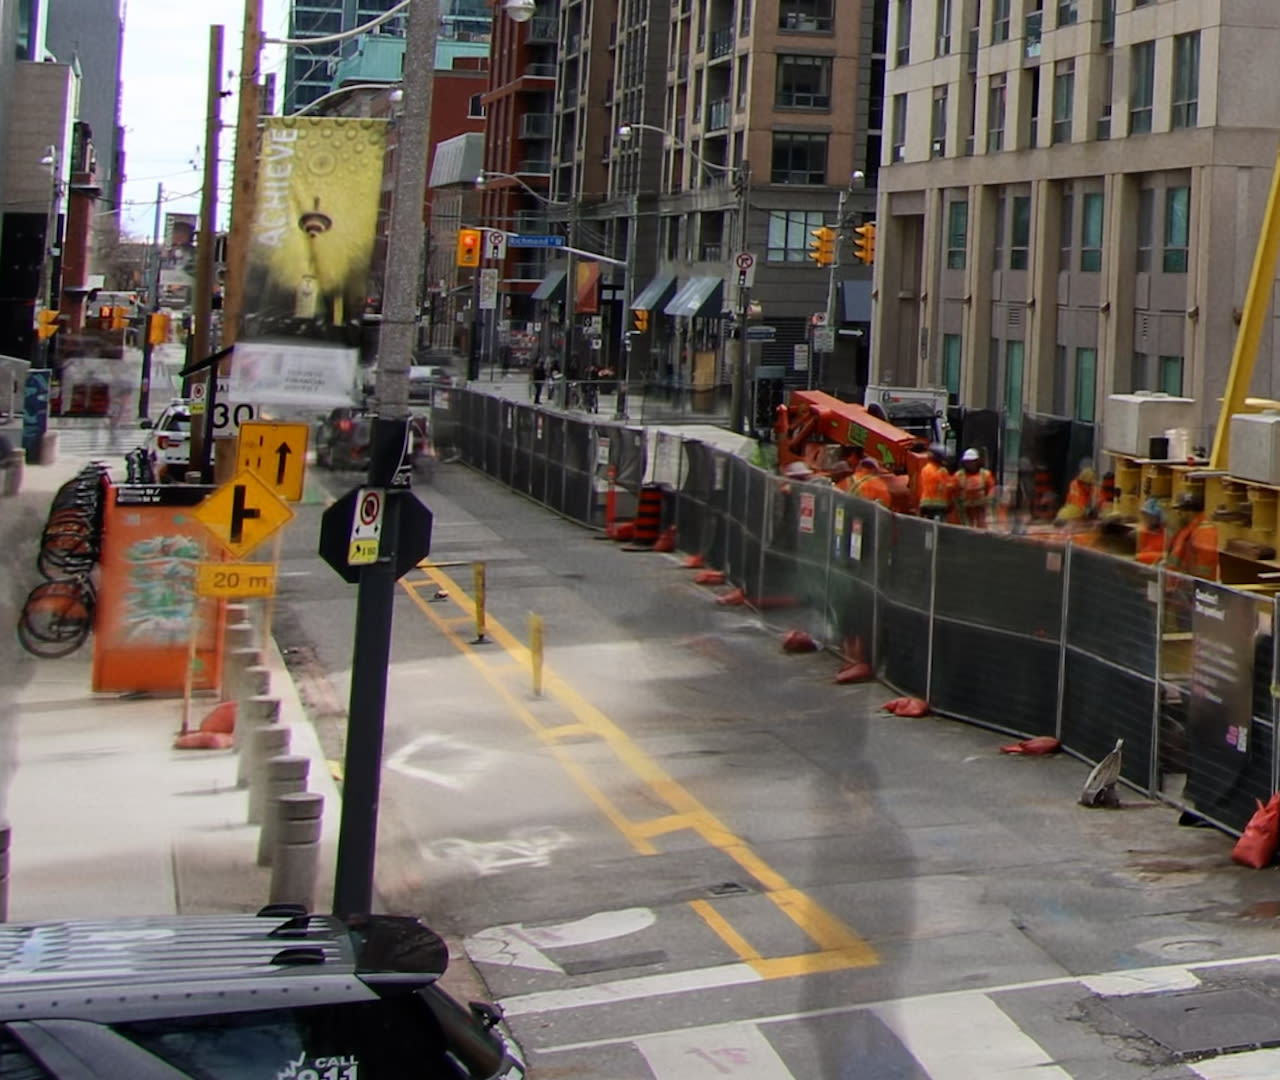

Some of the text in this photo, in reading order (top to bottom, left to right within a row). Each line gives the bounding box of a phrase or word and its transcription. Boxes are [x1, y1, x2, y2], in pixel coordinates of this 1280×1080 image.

[256, 128, 298, 248] ACHIEVE
[213, 403, 254, 429] 30
[213, 571, 267, 589] 20 m
[315, 1055, 359, 1068] CALL
